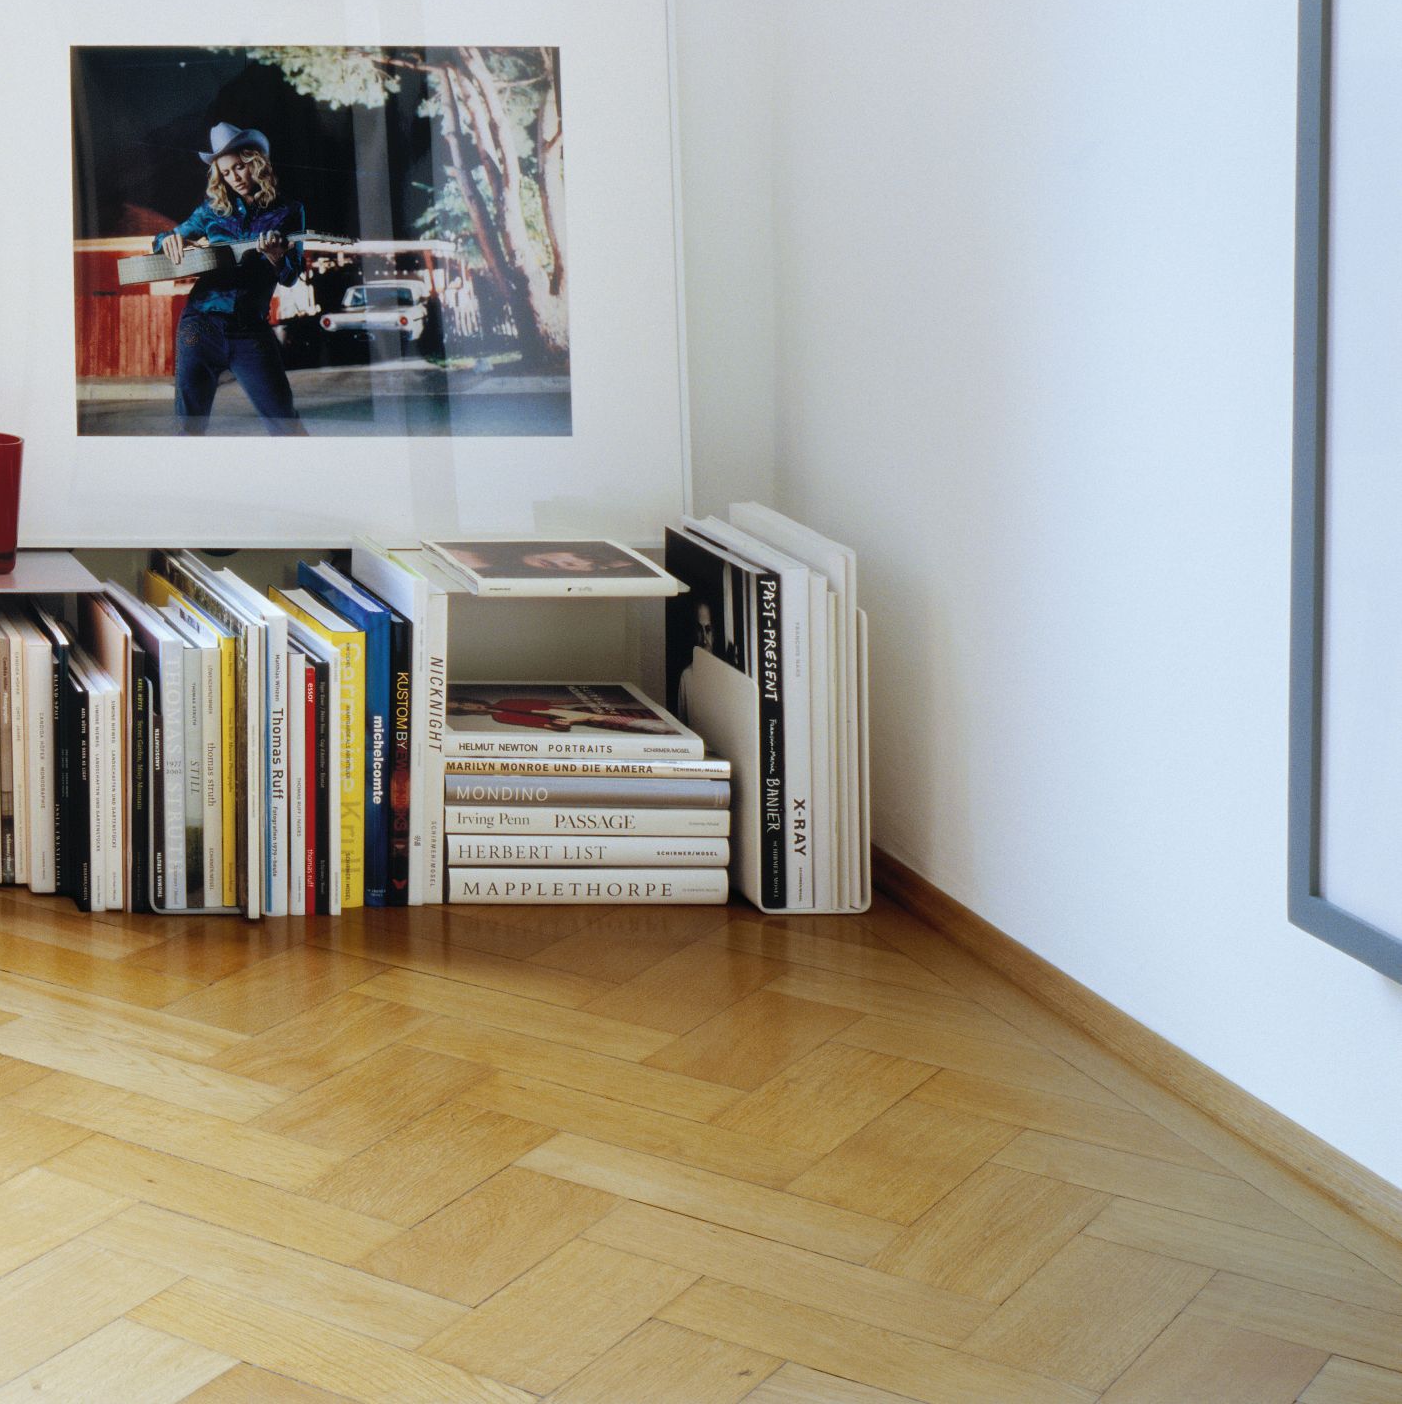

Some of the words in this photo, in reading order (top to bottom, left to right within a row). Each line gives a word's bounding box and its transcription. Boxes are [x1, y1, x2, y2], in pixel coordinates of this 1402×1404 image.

[761, 580, 778, 702] PAST-PRESENT
[396, 672, 408, 729] KUSTOM
[272, 708, 283, 765] Thomas
[397, 731, 408, 749] BY
[459, 743, 494, 751] HELMUT
[498, 744, 538, 752] NEWTON
[548, 744, 613, 754] PORTRAITS
[207, 743, 216, 776] thomas
[373, 716, 384, 805] michelcomte
[446, 762, 495, 772] MARILYN
[500, 763, 549, 772] MONROE
[554, 763, 577, 772] UND
[581, 763, 603, 773] DIE
[605, 764, 653, 774] KAMERA
[190, 760, 200, 795] STILL
[272, 770, 283, 799] Ruff
[207, 779, 217, 806] struth
[456, 786, 548, 801] MONDINO
[457, 812, 494, 828] Irving
[499, 813, 530, 825] Penn
[554, 814, 636, 829] PASSAGE
[793, 798, 807, 857] X-RAY
[458, 845, 552, 859] HERBERT
[563, 846, 607, 860] LIST
[463, 882, 672, 896] MAPPLETHORPE
